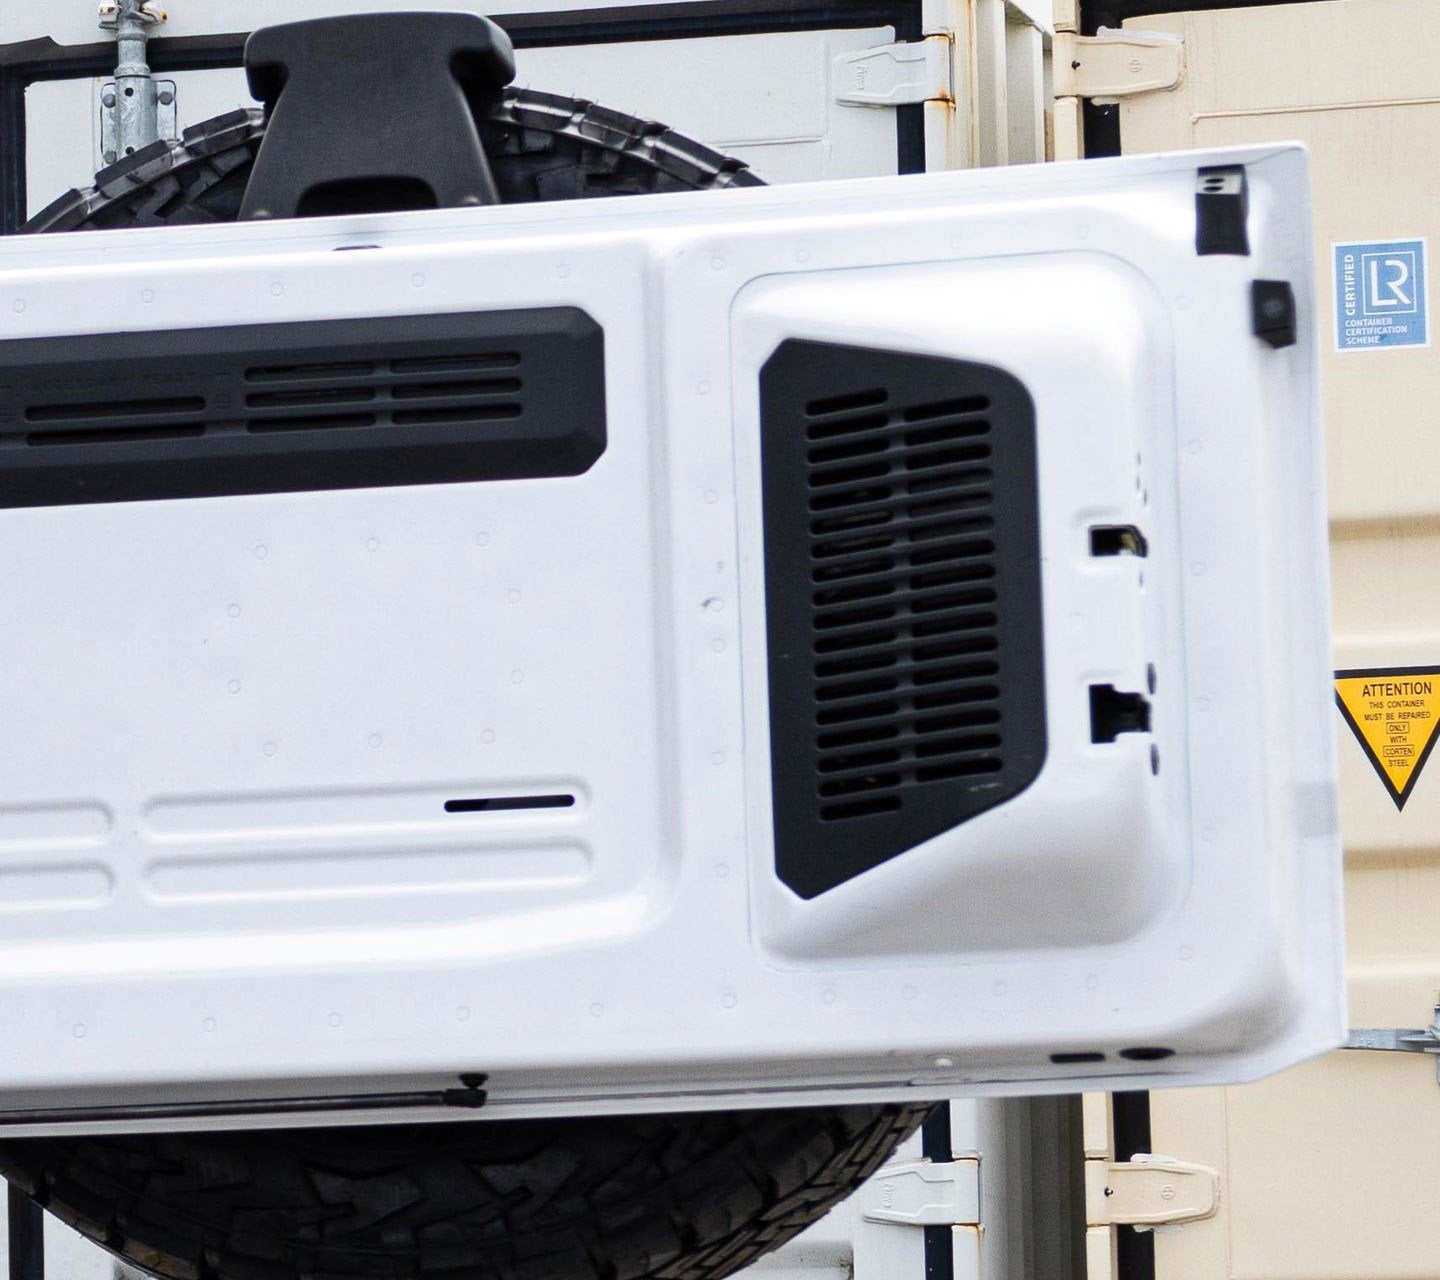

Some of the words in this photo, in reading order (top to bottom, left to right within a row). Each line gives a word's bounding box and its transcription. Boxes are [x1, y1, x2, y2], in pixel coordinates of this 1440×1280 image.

[1344, 254, 1356, 316] CERTIFIED
[1345, 317, 1393, 328] CONTAINER
[1345, 325, 1408, 336] CERTIFICATION
[1345, 335, 1380, 345] SCHEME
[1362, 682, 1432, 697] ATTENTION
[1369, 701, 1384, 709] THIS
[1387, 700, 1424, 709] CONTAINER
[1364, 713, 1382, 721] MUST
[1386, 712, 1395, 720] BE
[1398, 711, 1431, 720] REPAIRED
[1389, 724, 1406, 732] ONLY
[1385, 747, 1413, 755] CORTEN
[1389, 759, 1409, 767] STEEL
